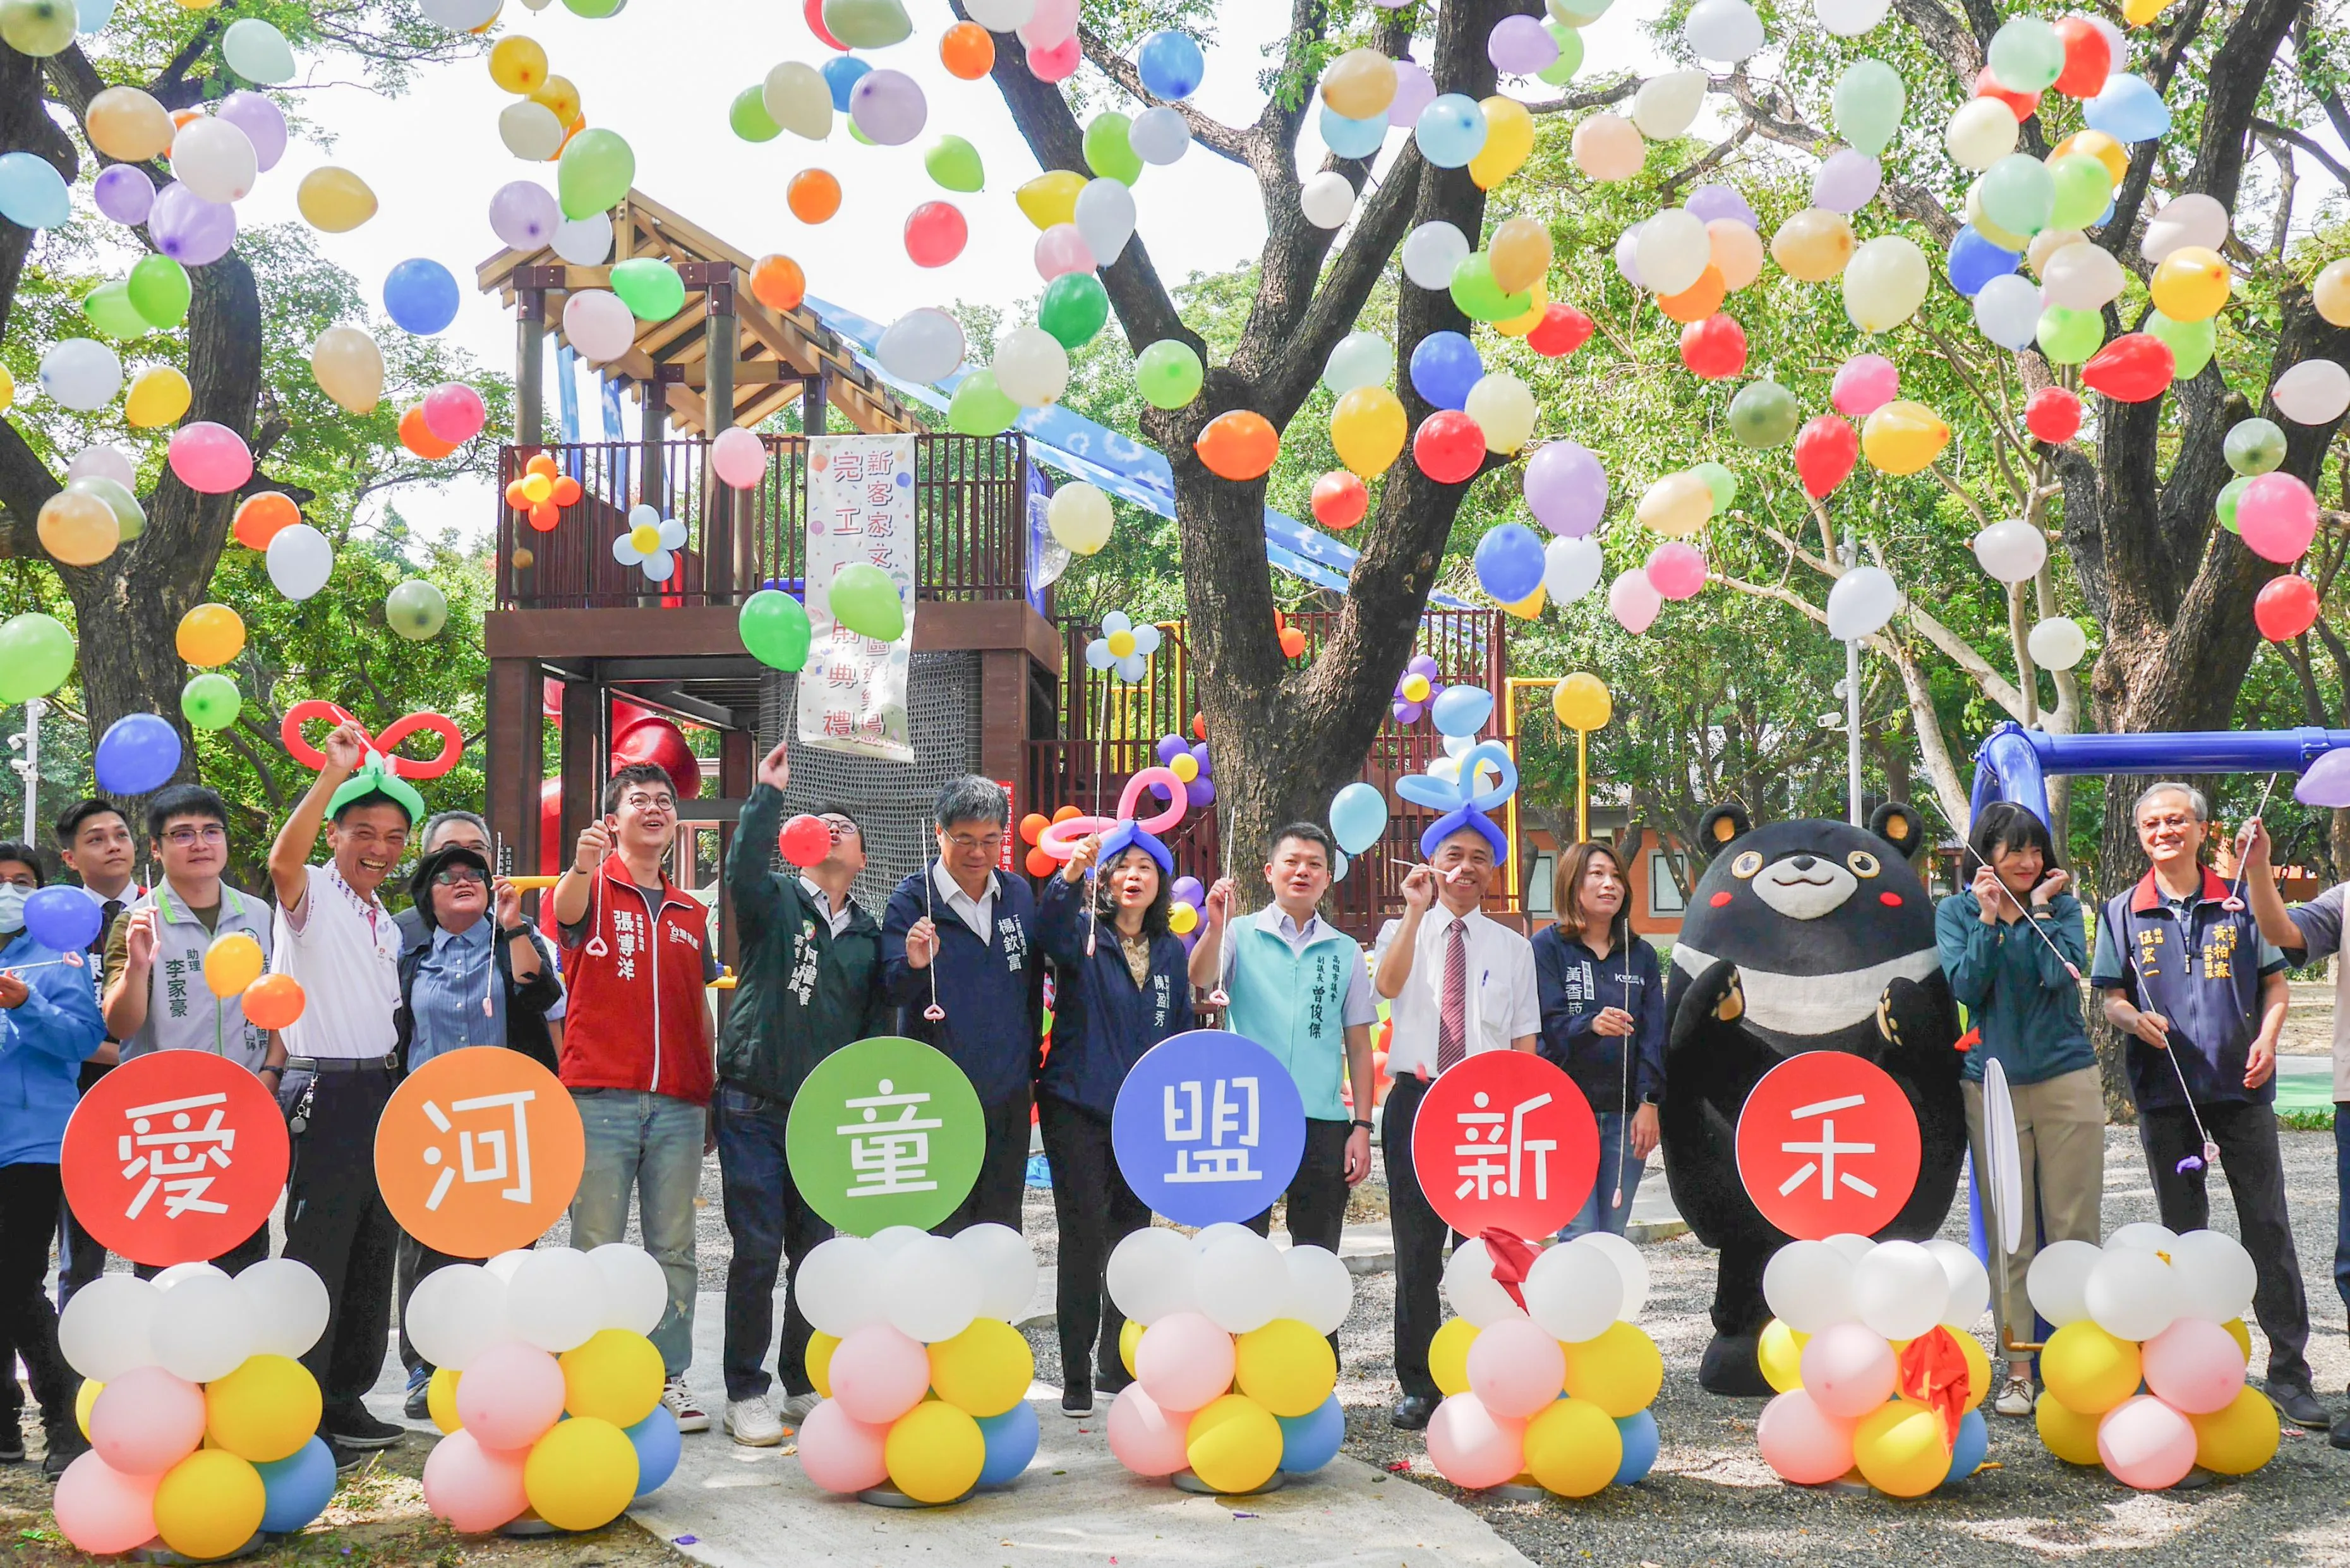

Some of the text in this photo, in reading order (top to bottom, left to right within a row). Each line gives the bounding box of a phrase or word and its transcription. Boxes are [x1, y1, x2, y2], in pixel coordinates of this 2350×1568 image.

[823, 450, 860, 737] 完工用典禮
[186, 948, 202, 972] 助理
[613, 910, 635, 981] 張博洋
[997, 917, 1022, 972] 楊欽富
[1330, 955, 1340, 1003] 高雄市議會
[2137, 930, 2160, 977] 伍宏一
[166, 959, 188, 1018] 李家豪
[1154, 975, 1166, 1027] 陳盈秀
[1309, 956, 1325, 1039] 副議長 曾俊傑
[119, 1093, 235, 1219] 愛
[423, 1091, 535, 1210] 河
[837, 1079, 942, 1197] 童
[1164, 1077, 1262, 1182] 盟
[1455, 1092, 1557, 1200] 新
[1779, 1095, 1877, 1199] 禾
